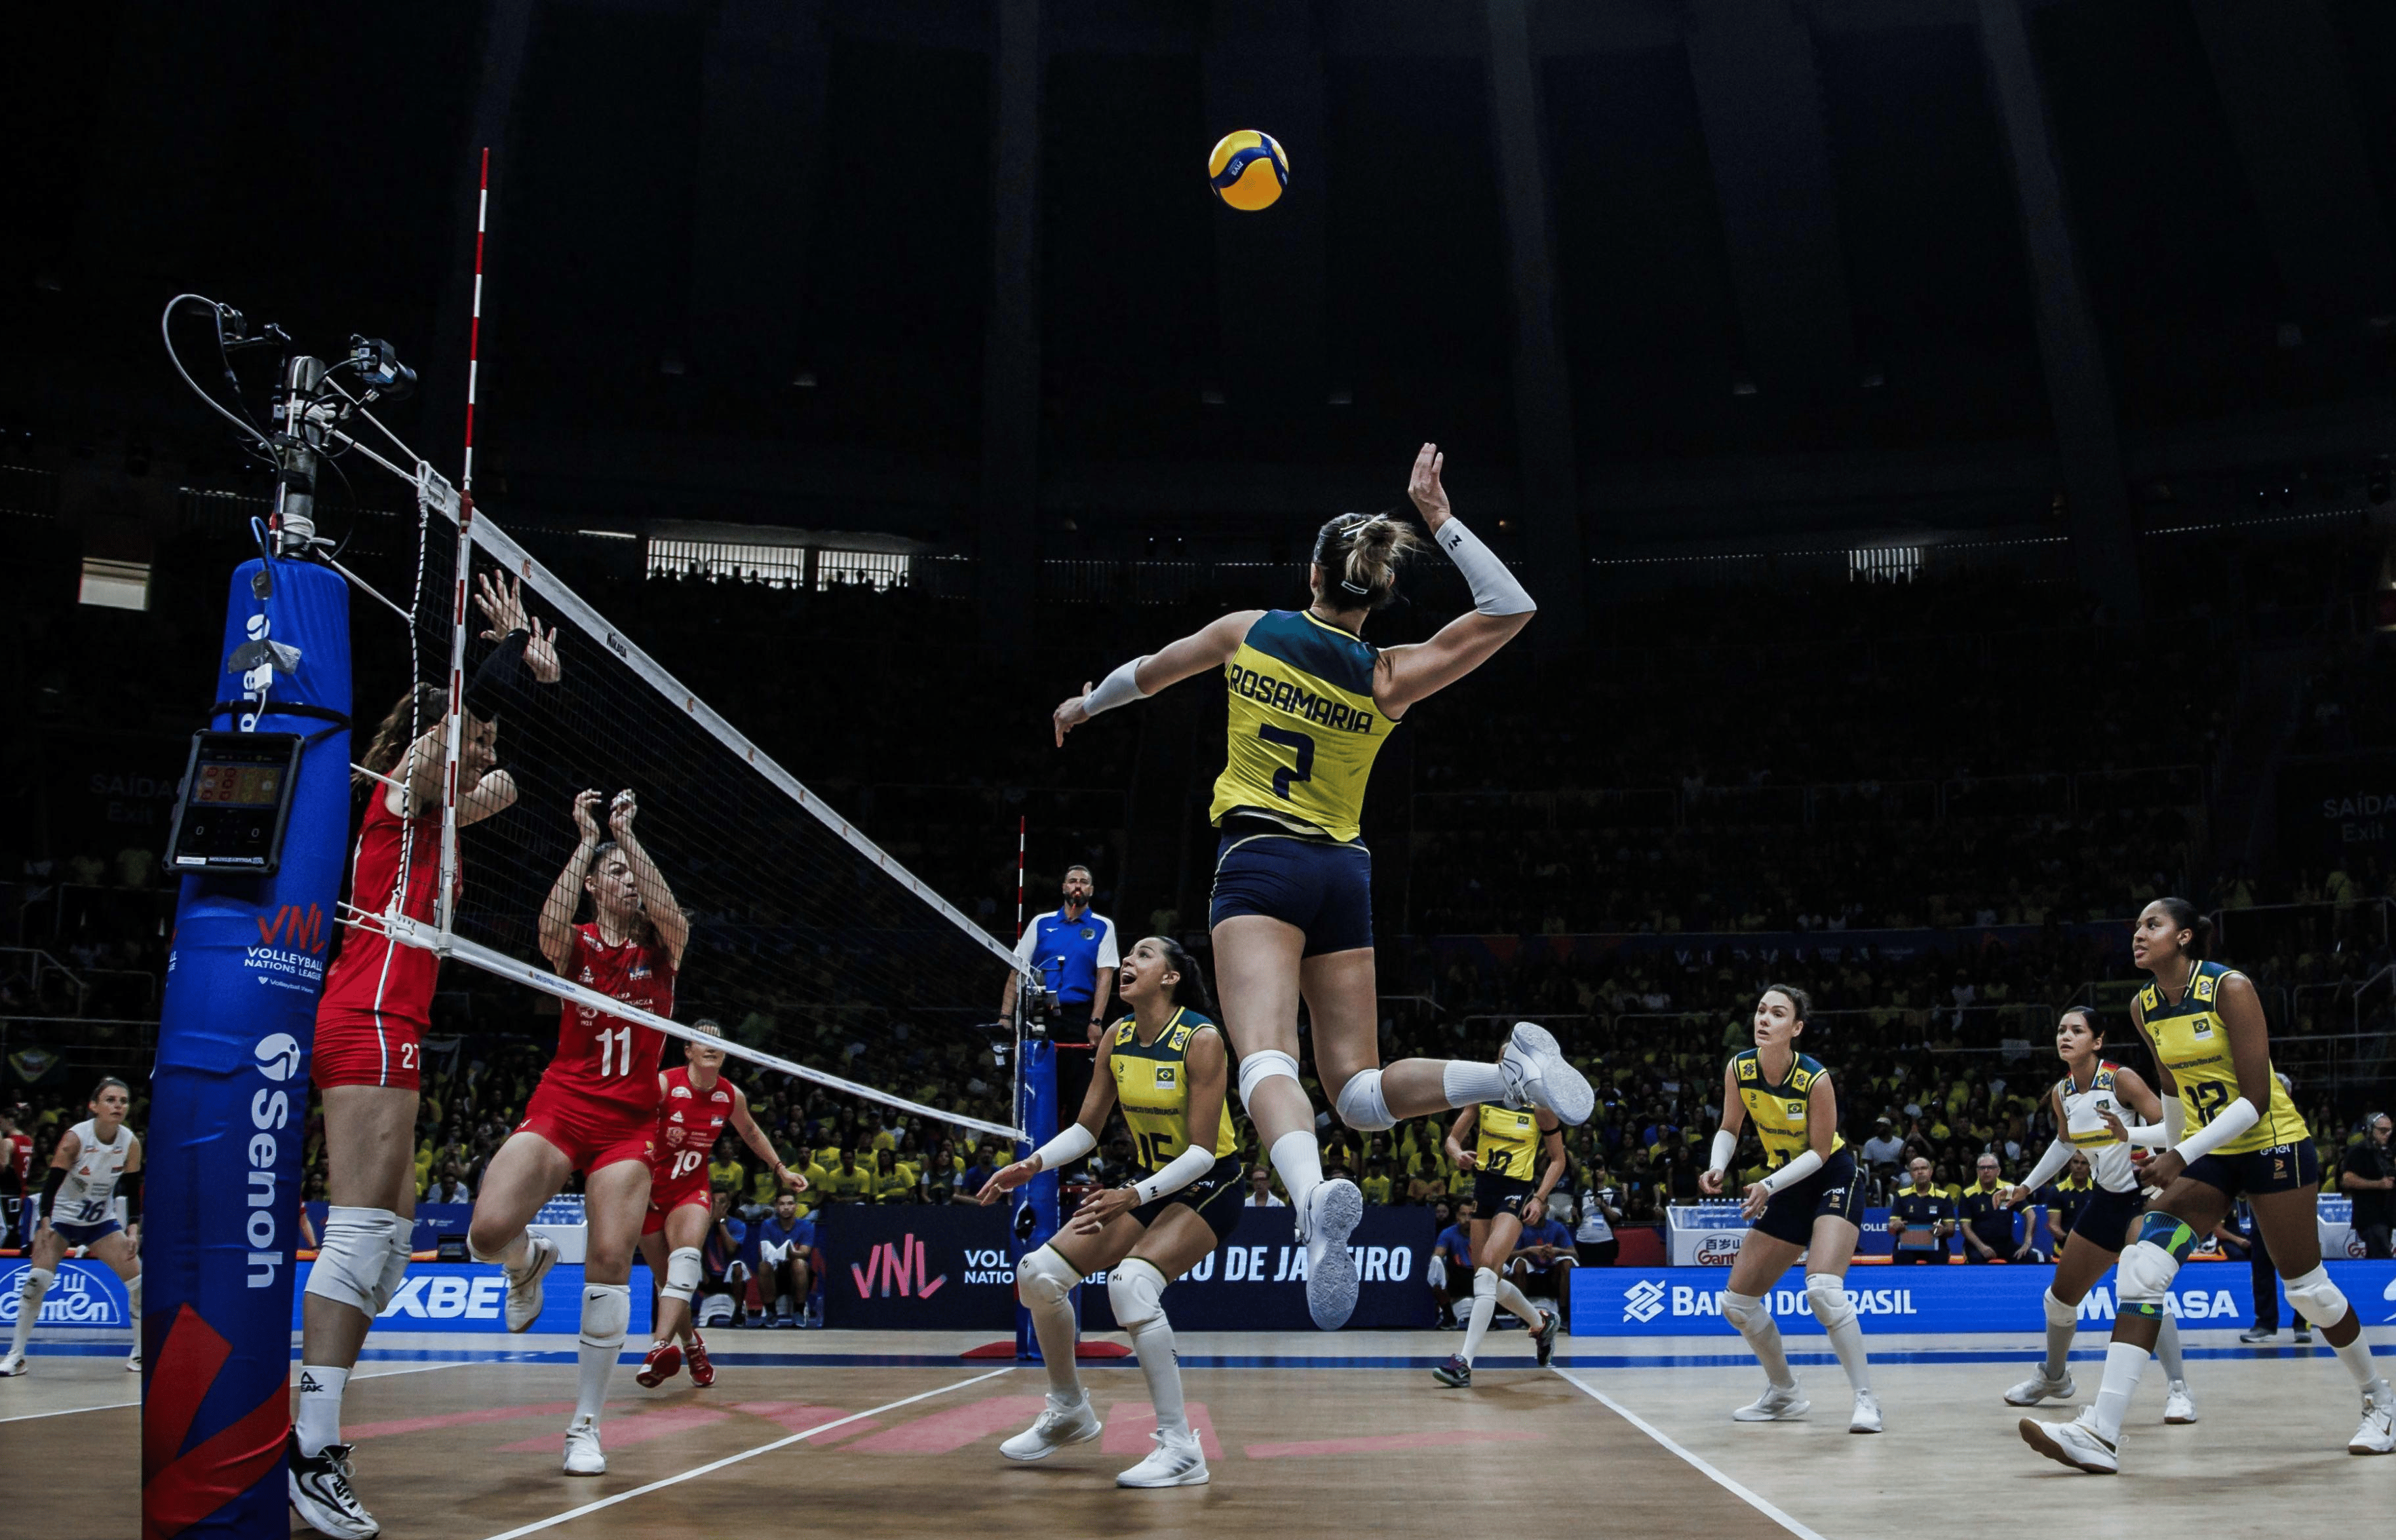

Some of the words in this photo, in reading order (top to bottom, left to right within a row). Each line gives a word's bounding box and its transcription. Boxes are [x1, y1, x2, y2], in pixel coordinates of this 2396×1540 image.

[1229, 663, 1374, 733] ROSAMARIA
[1258, 722, 1315, 800] 7
[258, 903, 326, 954] VNL
[244, 959, 296, 974] NATIONS
[298, 969, 322, 981] LEAGUE
[247, 946, 323, 972] VOLLEYBALL
[595, 1026, 630, 1077] 11
[2184, 1080, 2228, 1128] 12
[670, 1149, 703, 1180] 10
[1138, 1132, 1177, 1174] 15
[2260, 1143, 2291, 1156] enel
[246, 1088, 288, 1288] Senoh
[77, 1199, 106, 1223] 16
[851, 1233, 948, 1299] VNL
[1224, 1246, 1267, 1281] DE
[1273, 1246, 1412, 1281] JAIRO
[0, 1292, 109, 1322] Gnten
[1843, 1289, 1918, 1315] RASIL
